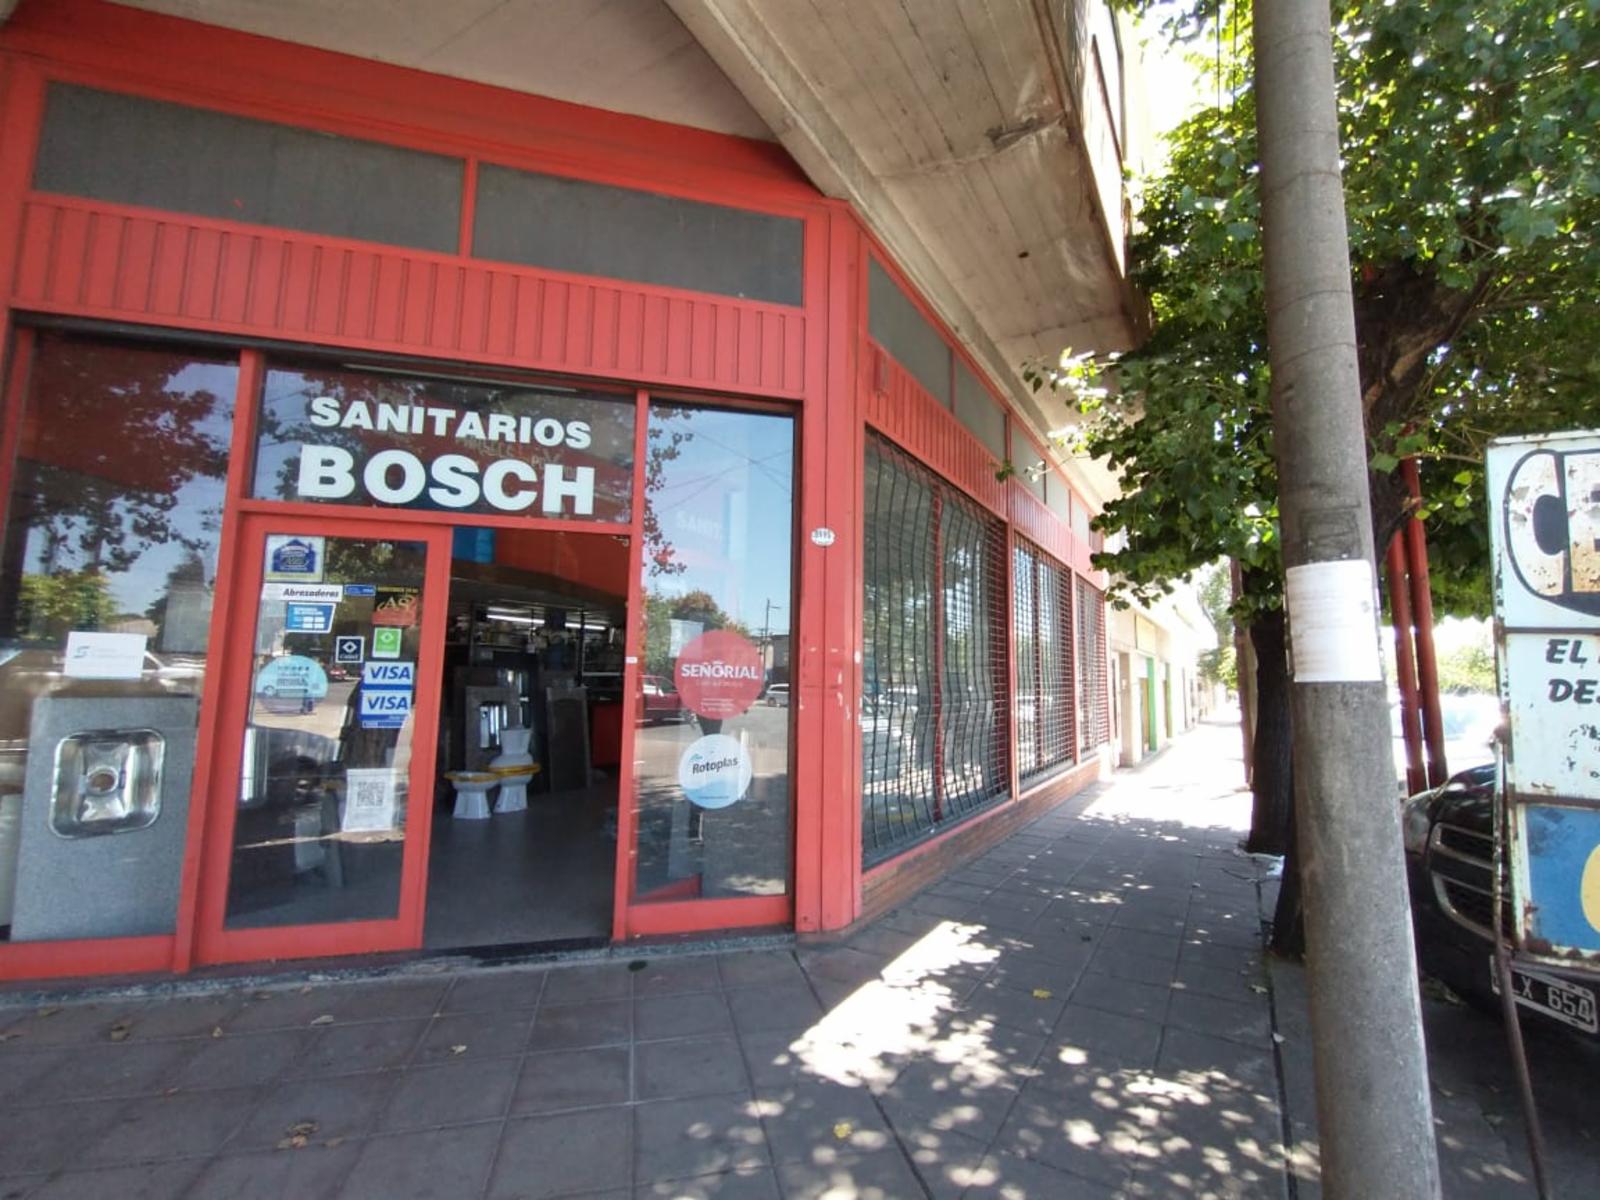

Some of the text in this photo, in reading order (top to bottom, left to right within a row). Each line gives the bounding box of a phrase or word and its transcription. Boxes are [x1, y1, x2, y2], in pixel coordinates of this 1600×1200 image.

[309, 396, 592, 450] SANITARIOS
[298, 444, 596, 515] BOSCH
[1546, 638, 1588, 665] EL
[371, 666, 410, 680] VISA
[368, 696, 408, 710] VISA
[1548, 678, 1600, 705] DE
[692, 757, 738, 775] Rotoplas
